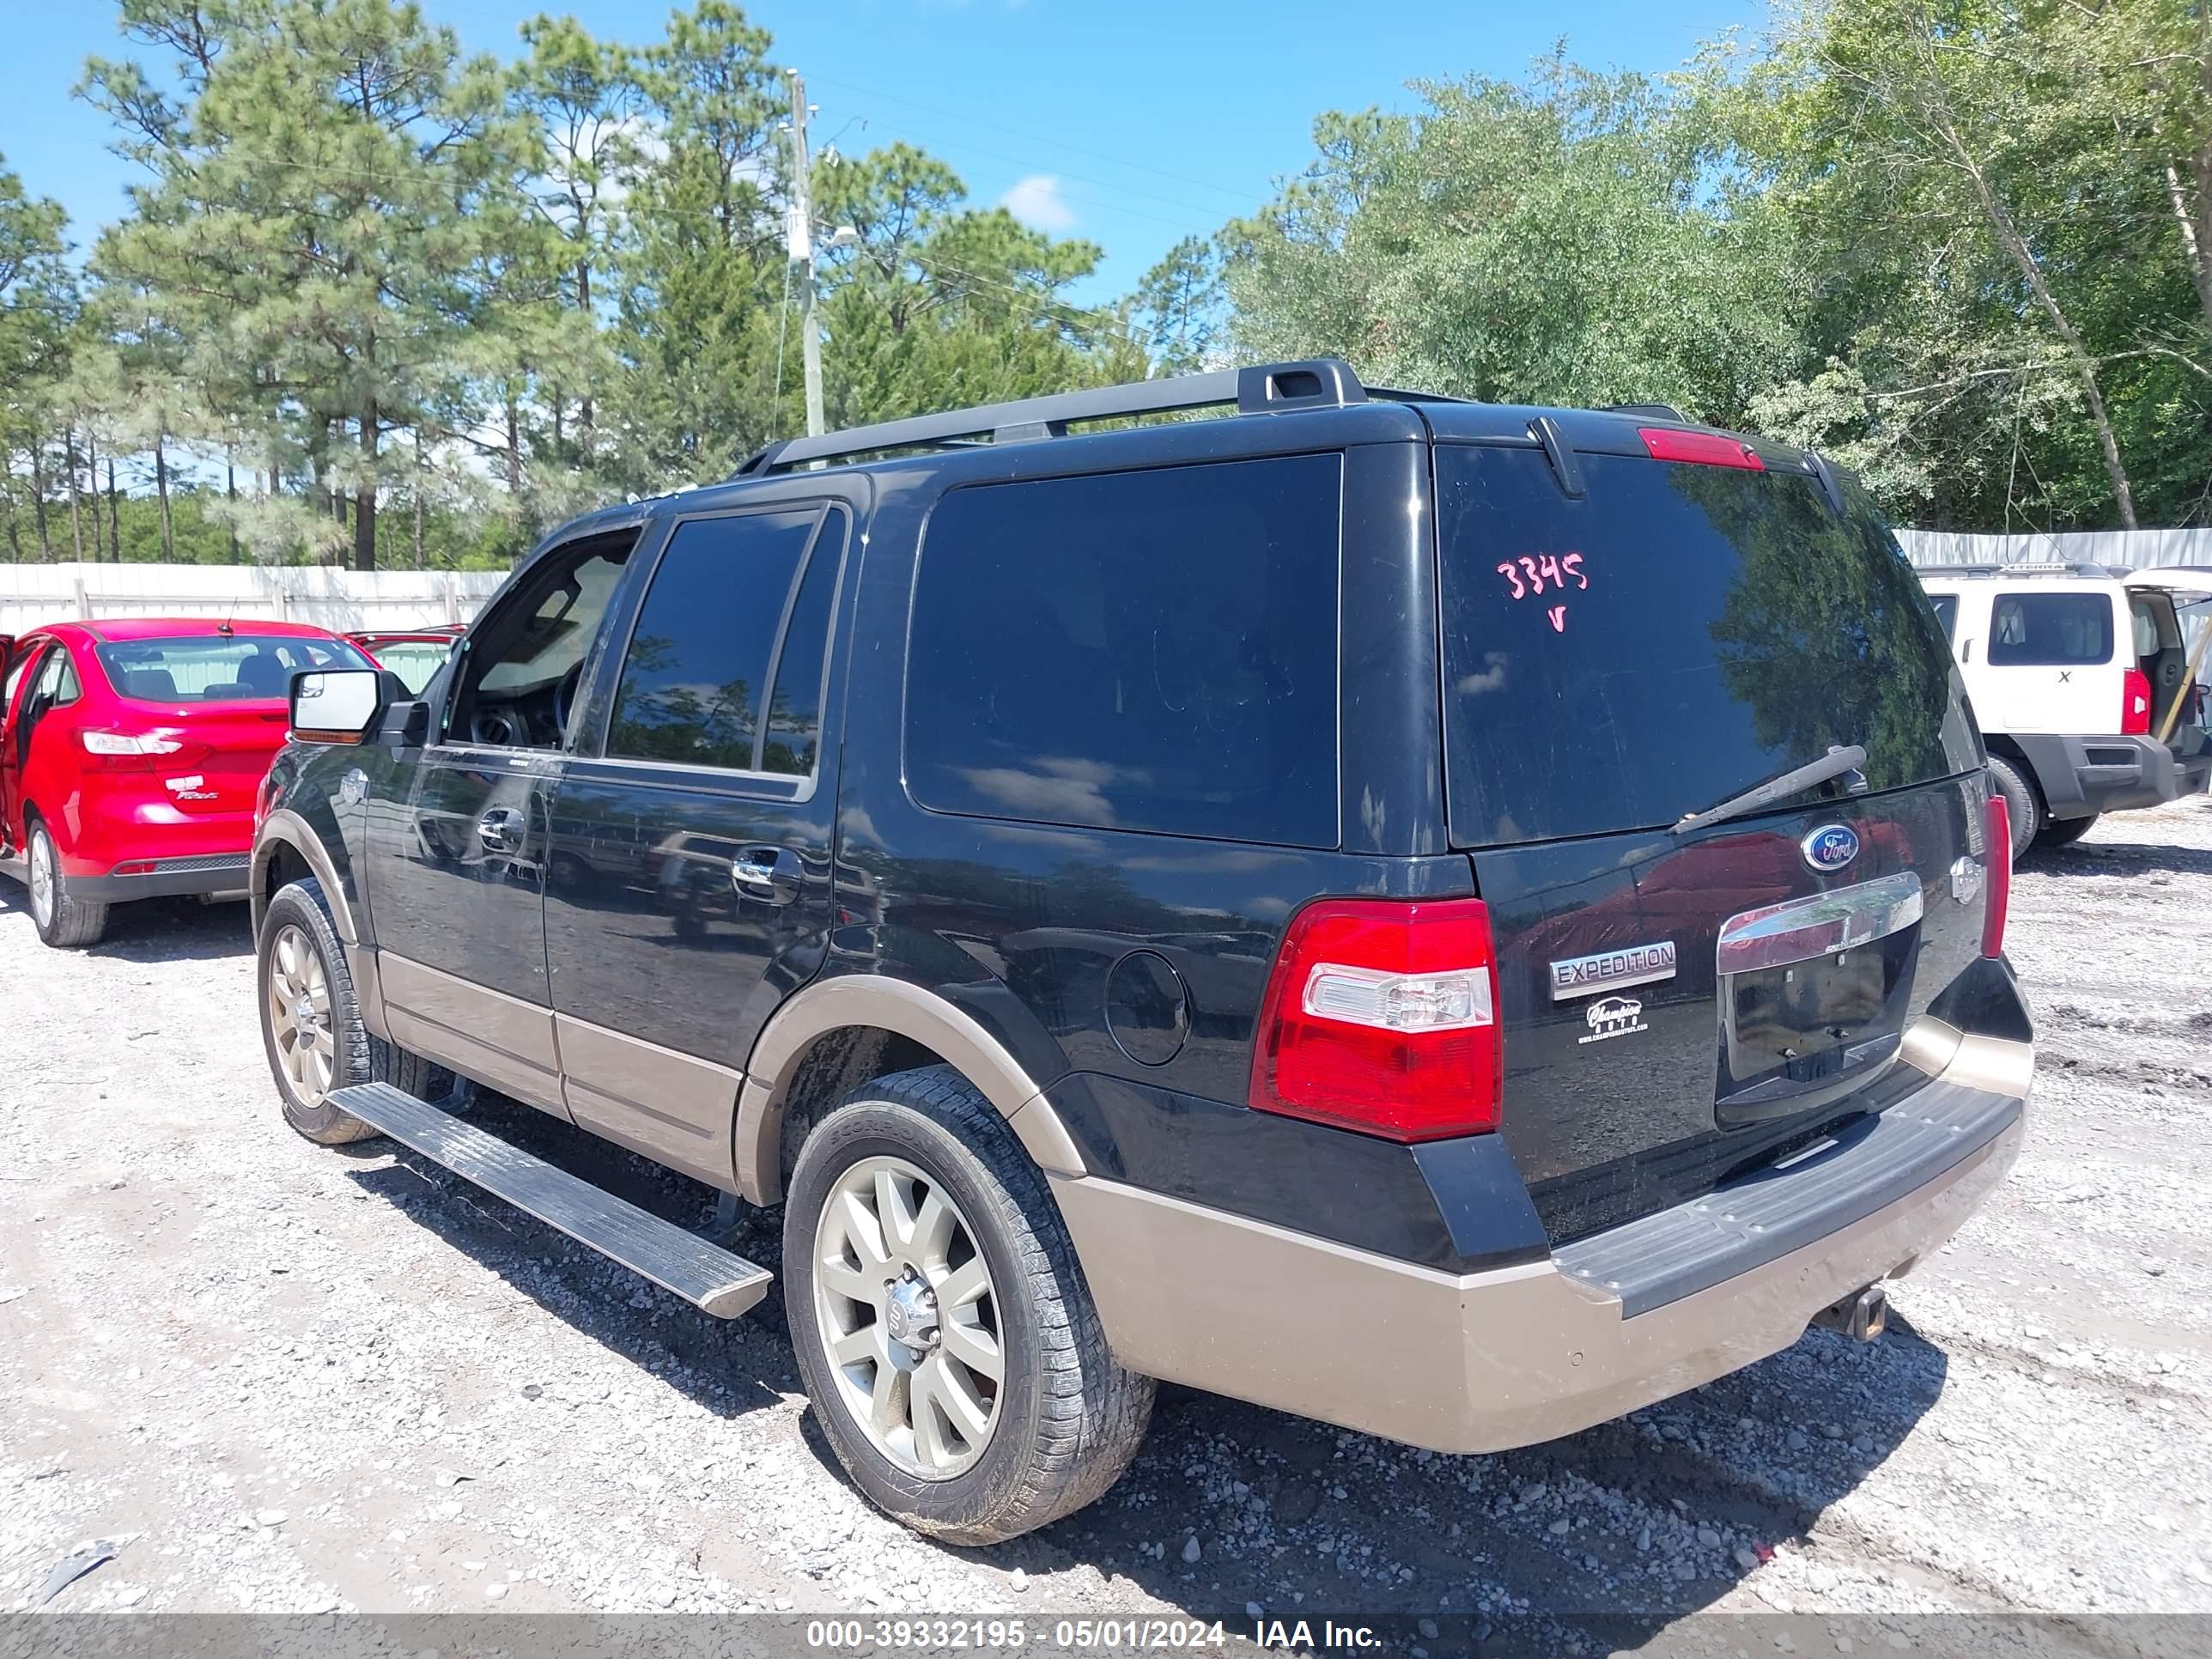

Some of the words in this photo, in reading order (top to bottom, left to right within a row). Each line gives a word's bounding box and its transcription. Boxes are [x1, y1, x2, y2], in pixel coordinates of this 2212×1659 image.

[1497, 552, 1588, 599] 3345
[2058, 671, 2072, 684] X
[1823, 833, 1852, 861] Ford
[1557, 945, 1675, 985] EXPEDITION
[830, 1119, 933, 1155] SCORPION
